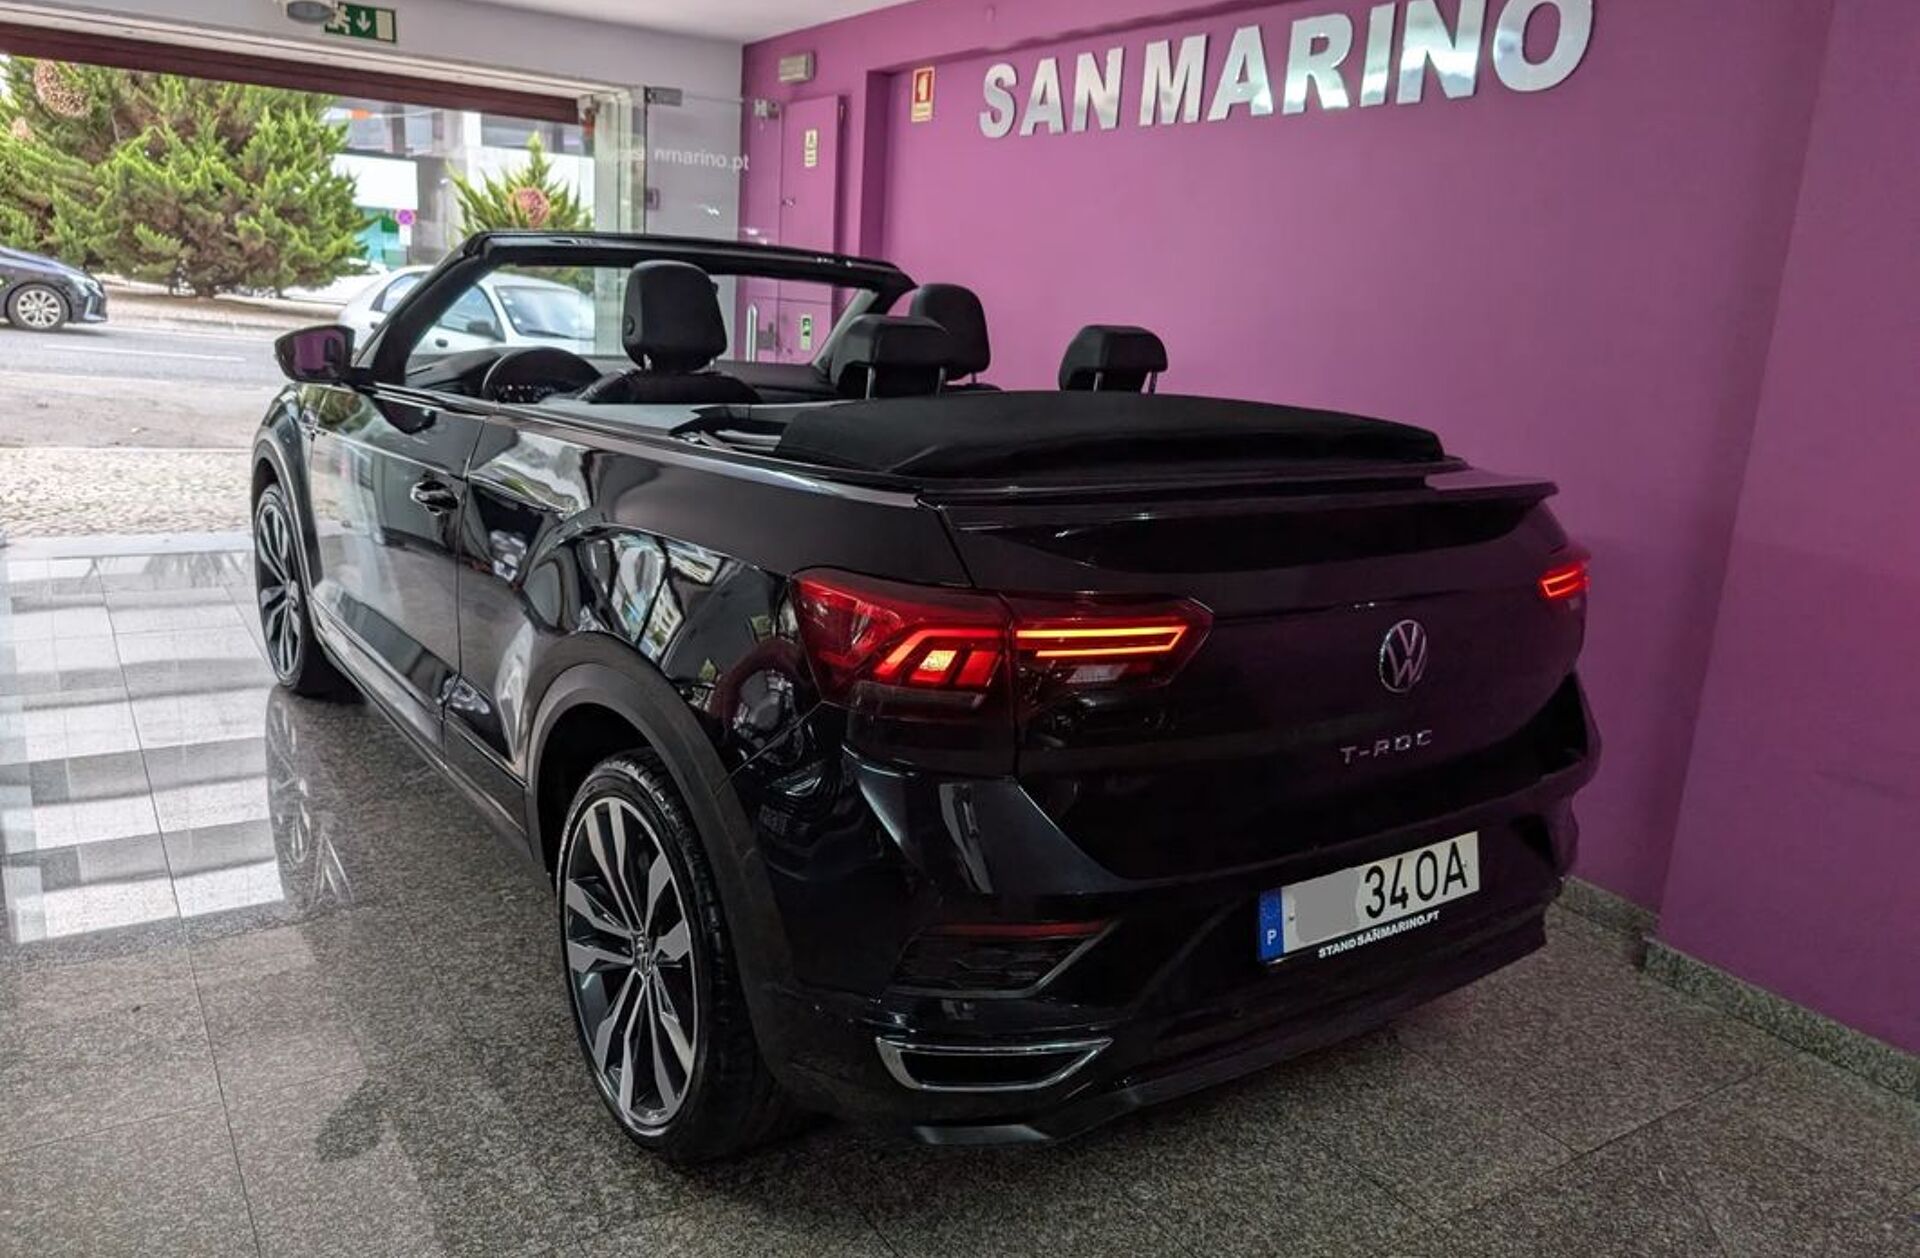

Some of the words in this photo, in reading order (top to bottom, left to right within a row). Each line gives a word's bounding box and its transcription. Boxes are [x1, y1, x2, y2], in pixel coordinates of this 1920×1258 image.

[979, 47, 1125, 138] SAN
[1139, 0, 1594, 126] MARINO
[1339, 729, 1432, 764] T-ROC
[1266, 928, 1278, 946] P
